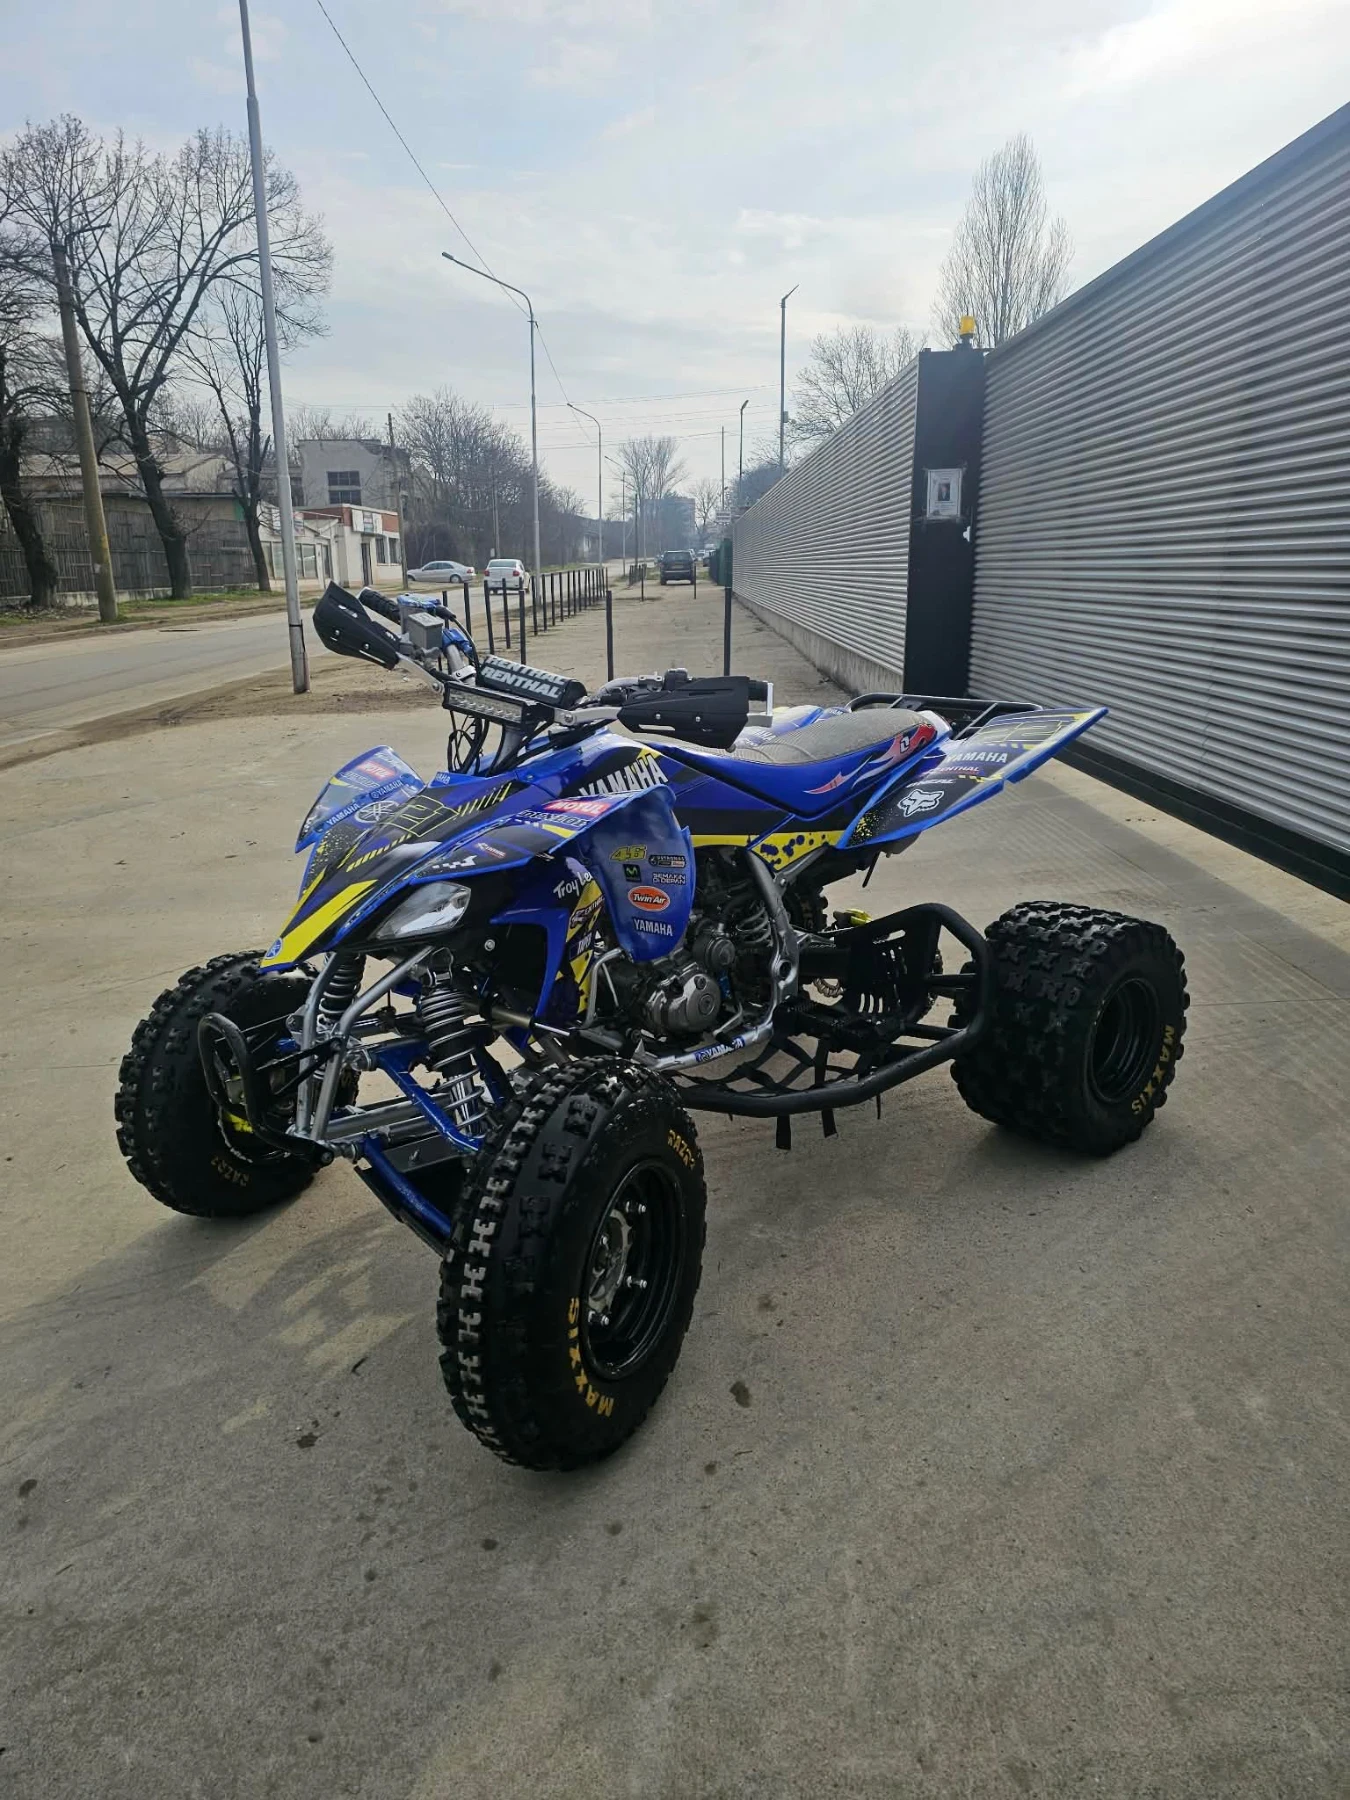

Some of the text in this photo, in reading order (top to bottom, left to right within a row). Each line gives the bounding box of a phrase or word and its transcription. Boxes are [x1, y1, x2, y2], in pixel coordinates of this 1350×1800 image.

[481, 666, 562, 699] RENTHAL
[947, 751, 1008, 763] YAMAHA
[378, 780, 404, 797] YAMAHA
[326, 803, 360, 826] YAMAHA
[554, 801, 604, 816] MOTUL
[611, 844, 648, 862] 46
[553, 880, 580, 898] Troy
[633, 893, 667, 904] Twin Air
[633, 919, 673, 937] YAMAHA
[1131, 1024, 1175, 1115] MAXXIS
[567, 1297, 614, 1417] MAXXIS
